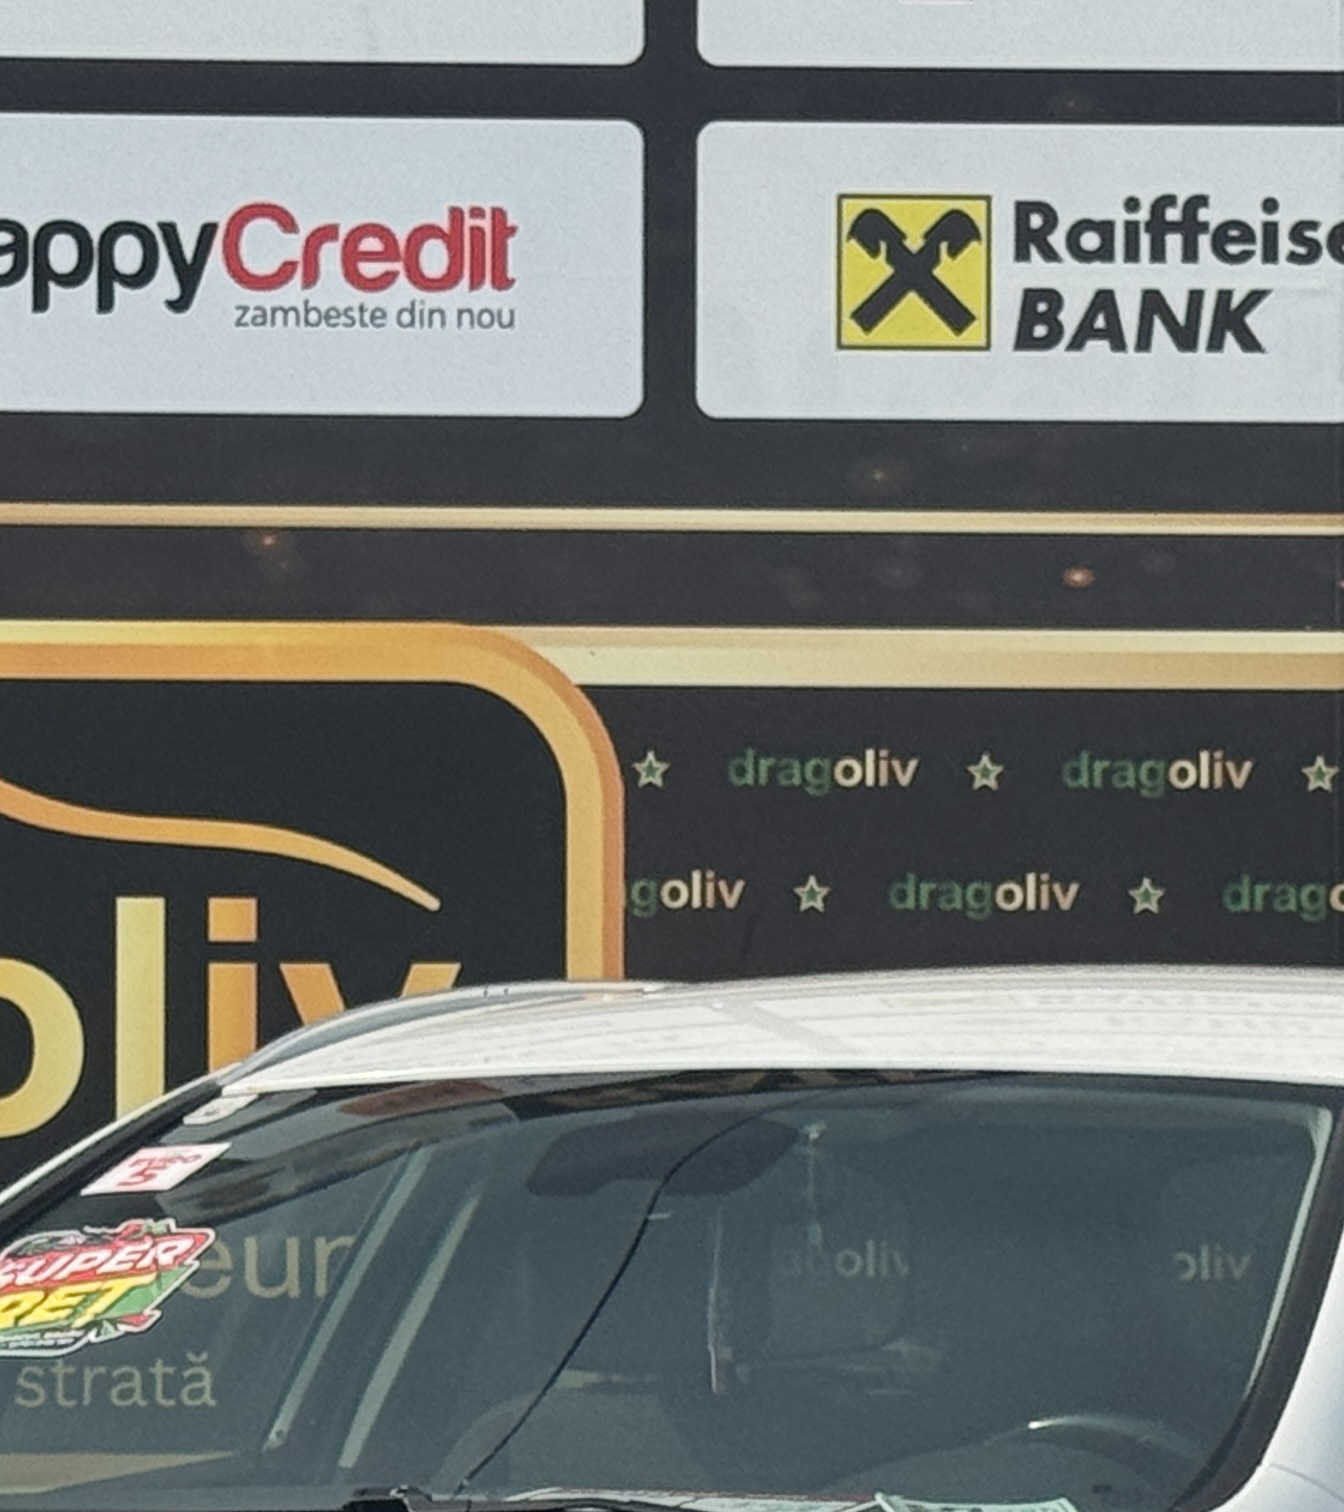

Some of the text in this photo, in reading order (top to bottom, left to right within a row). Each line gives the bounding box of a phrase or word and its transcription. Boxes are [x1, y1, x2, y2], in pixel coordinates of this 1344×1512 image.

[233, 301, 516, 331] zambeste din nou
[1013, 288, 1272, 354] BANK
[728, 749, 919, 795] dragoliv
[1062, 751, 1253, 797] dragoliv
[631, 869, 746, 917] goliv
[889, 870, 1079, 919] dragoliv
[14, 1351, 217, 1408] strată
